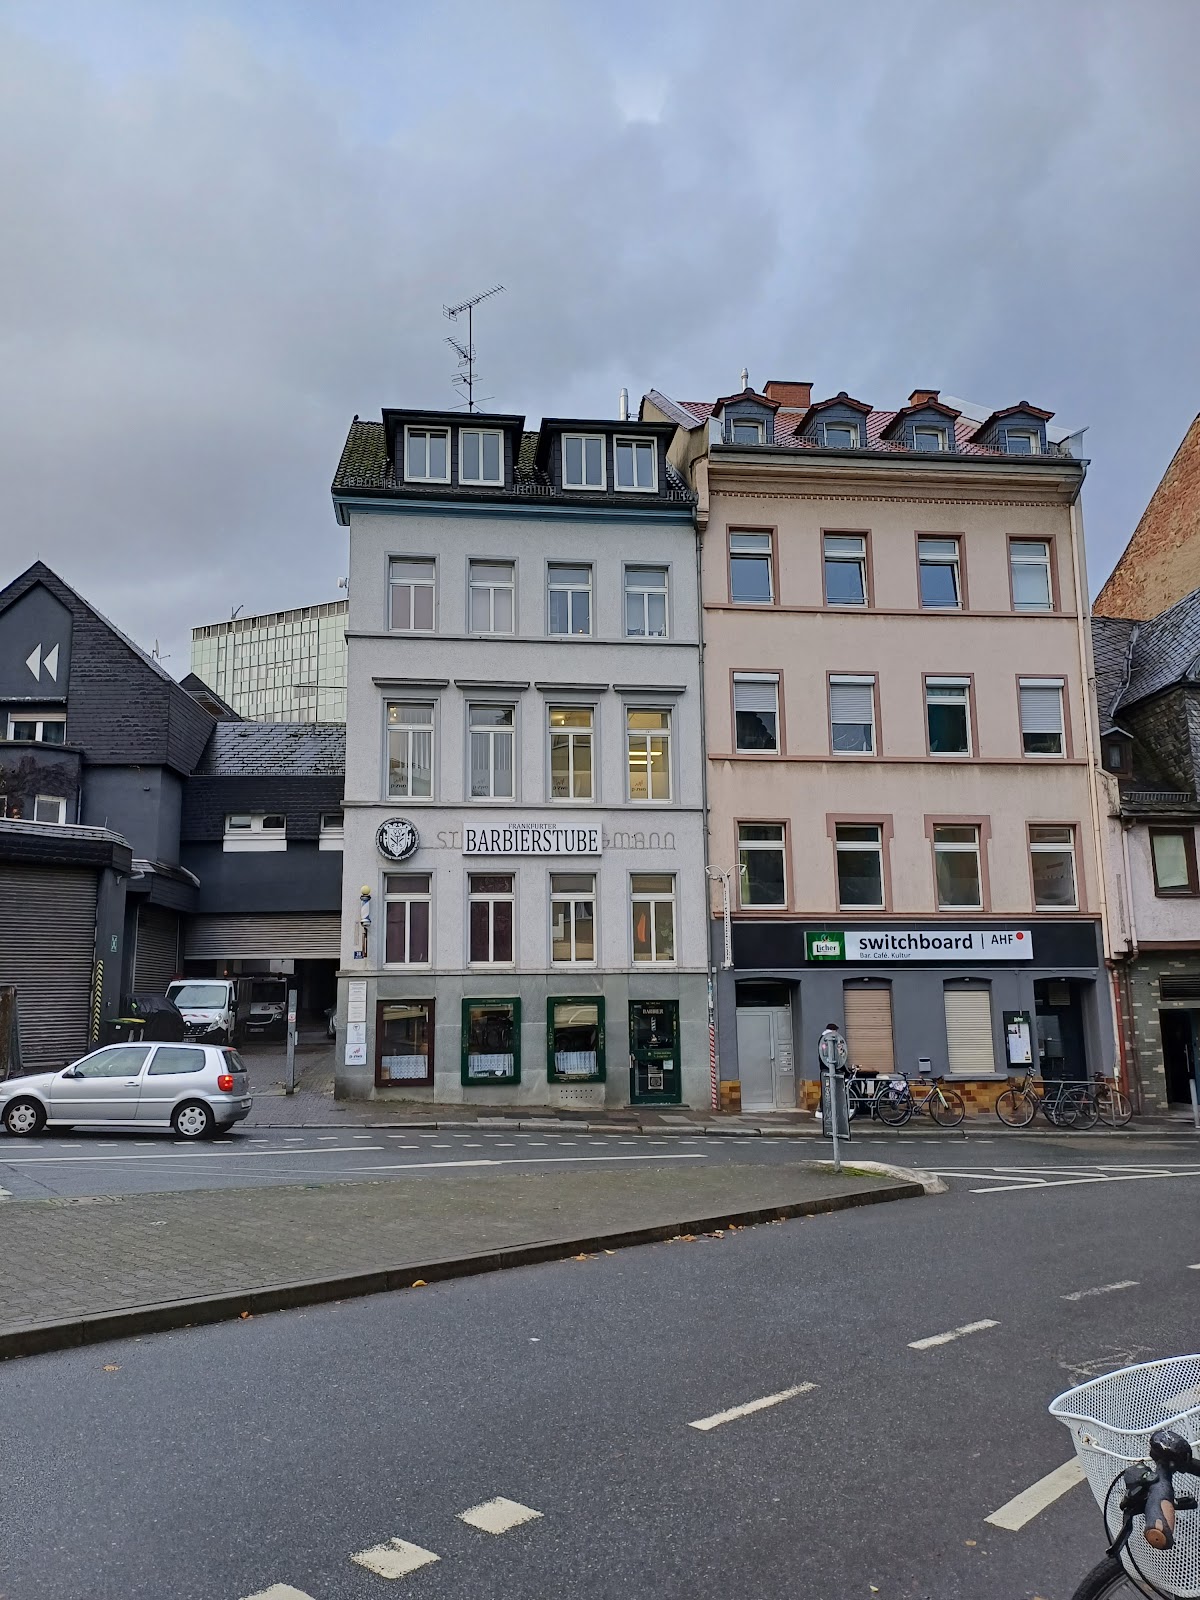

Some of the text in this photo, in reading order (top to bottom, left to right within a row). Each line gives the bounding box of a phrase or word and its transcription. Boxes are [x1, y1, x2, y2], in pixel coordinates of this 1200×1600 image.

[466, 829, 598, 852] BARBIERSTUBE
[859, 933, 973, 950] switchboard
[991, 934, 1014, 945] AHF
[816, 943, 837, 953] Licher
